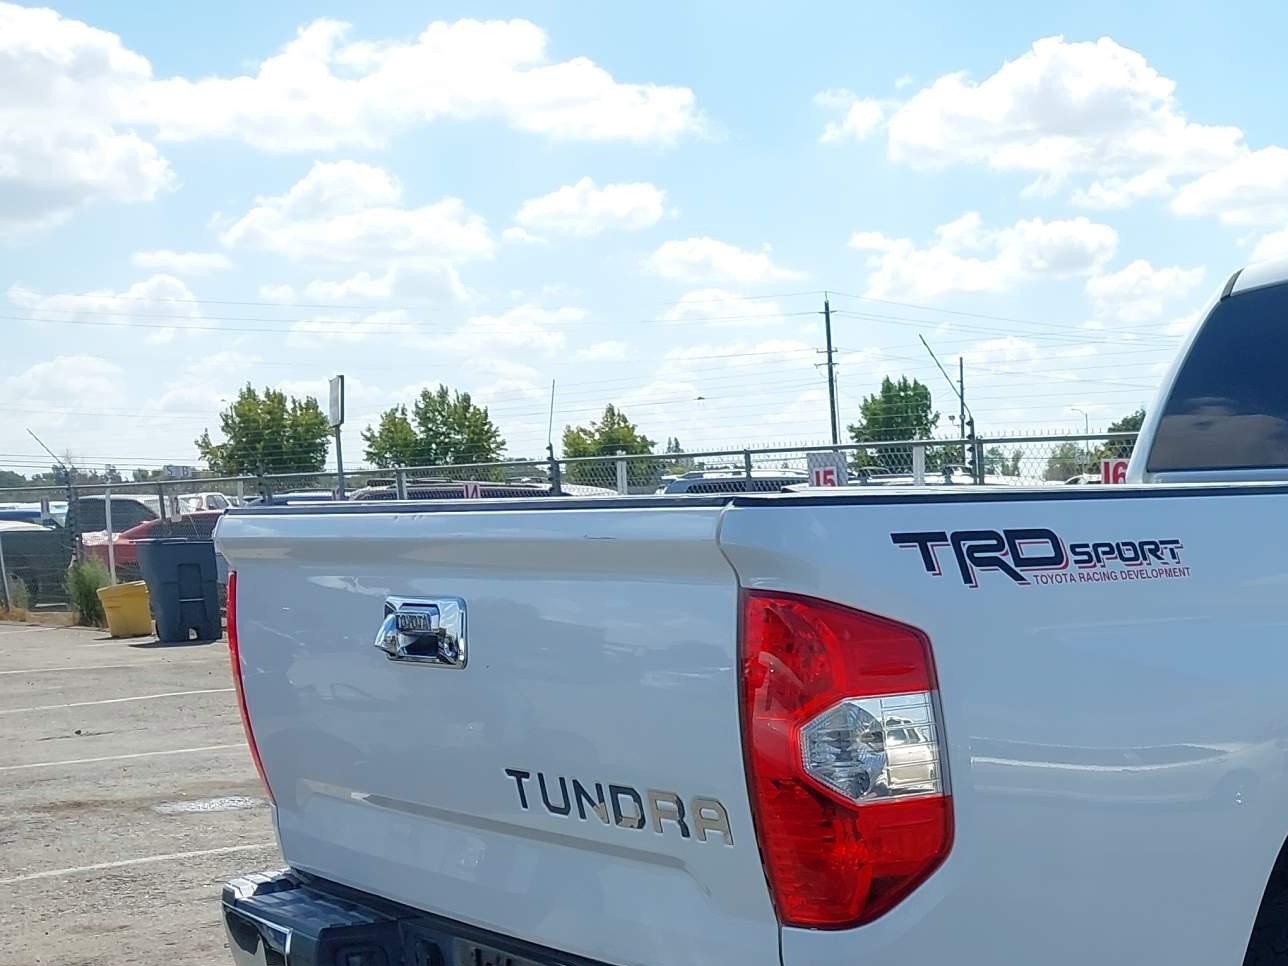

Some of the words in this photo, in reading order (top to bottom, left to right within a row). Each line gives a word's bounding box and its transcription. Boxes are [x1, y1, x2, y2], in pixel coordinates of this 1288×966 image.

[815, 469, 836, 487] 15
[890, 529, 1068, 588] TRD
[1069, 539, 1184, 568] SPORT
[1033, 574, 1077, 585] TOYOTA
[1079, 570, 1118, 582] RACING
[1120, 567, 1191, 580] DEVELOPMENT
[504, 768, 735, 848] TUNDRA
